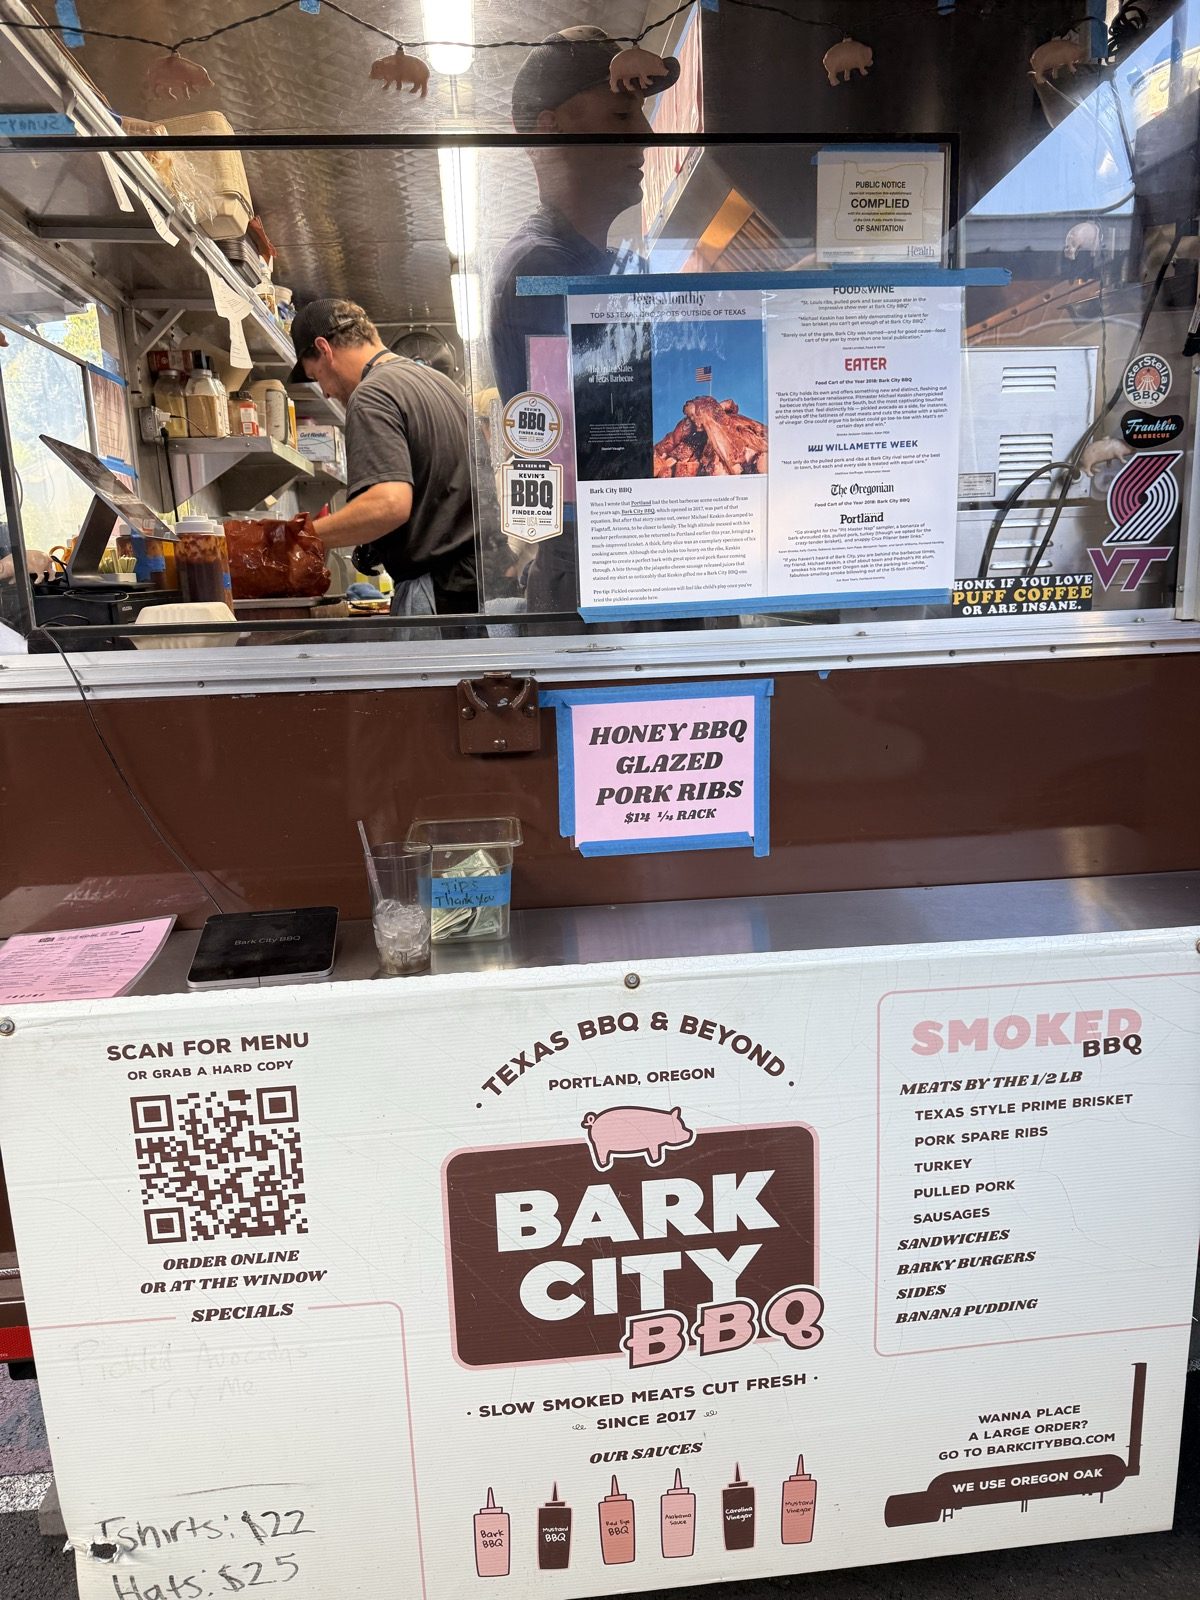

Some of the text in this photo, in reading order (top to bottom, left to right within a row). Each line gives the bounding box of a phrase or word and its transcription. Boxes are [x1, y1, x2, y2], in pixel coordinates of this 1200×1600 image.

[851, 198, 910, 208] COMPLIED
[907, 246, 935, 257] Health
[844, 357, 887, 371] EATER
[1127, 357, 1168, 392] InterStellar
[1133, 391, 1160, 402] BBQ
[518, 411, 546, 432] BBQ
[1126, 419, 1177, 434] Franklin
[825, 440, 918, 451] WILLAMETTE WEEK
[511, 480, 553, 509] BBQ
[831, 482, 895, 497] The Oregonian
[840, 512, 884, 524] Portland
[1087, 546, 1175, 592] VT
[953, 575, 1092, 590] HONK IF YOU LOVE
[953, 586, 1092, 605] PUFF COFFEE
[962, 601, 1081, 615] OR ARE INSANE.
[589, 719, 747, 745] HONEY BBQ
[616, 751, 723, 774] GLAZED
[596, 780, 744, 805] PORK RIBS
[624, 812, 650, 824] $14
[676, 808, 716, 820] RACK
[435, 893, 473, 906] Thank
[911, 1008, 1143, 1056] SMOKED
[106, 1032, 309, 1061] SCAN FOR MENU
[481, 1011, 785, 1096] TEXAS BBQ & BEYOND
[1083, 1033, 1142, 1058] BBQ
[127, 1060, 293, 1080] OR GRAB A HARD COPY
[549, 1067, 715, 1091] PORTLAND, OREGON
[900, 1070, 1083, 1096] MEATS BY THE 1/2 LB
[915, 1093, 1133, 1121] TEXAS STYLE PRIME BRISKET
[914, 1126, 1048, 1147] PORK SPARE RIBS
[914, 1158, 972, 1173] TURKEY
[914, 1180, 1016, 1199] PULLED PORK
[494, 1169, 780, 1253] BARK
[913, 1207, 990, 1225] SAUSAGES
[897, 1229, 1010, 1250] SANDWICHES
[163, 1250, 299, 1271] ORDER ONLINE
[896, 1250, 1036, 1276] BARKY BURGERS
[141, 1269, 328, 1294] OR AT THE WINDOW
[519, 1243, 763, 1321] CITY
[896, 1284, 946, 1300] SIDES
[191, 1302, 294, 1323] SPECIALS
[895, 1298, 1038, 1324] BANANA PUDDING
[624, 1286, 824, 1369] BBQ
[479, 1373, 807, 1418] SLOW SMOKED MEATS CUT FRESH
[596, 1410, 697, 1431] SINCE 2017
[978, 1405, 1081, 1424] WANNA PLACE
[968, 1420, 1088, 1442] A LARGE ORDER?
[589, 1442, 702, 1465] OUR SAUCES
[939, 1433, 1116, 1461] GO TO BARKCITYBBQ.COM
[952, 1468, 1103, 1493] WE USE OREGON OAK
[725, 1507, 753, 1515] Carolina
[726, 1513, 753, 1522] Vinegar
[786, 1507, 812, 1516] Vinegar
[241, 1510, 315, 1545] $22
[481, 1529, 504, 1538] Bark
[545, 1533, 566, 1542] BBQ
[608, 1526, 629, 1536] BBQ
[483, 1539, 504, 1548] BBQ
[218, 1553, 299, 1592] $25
